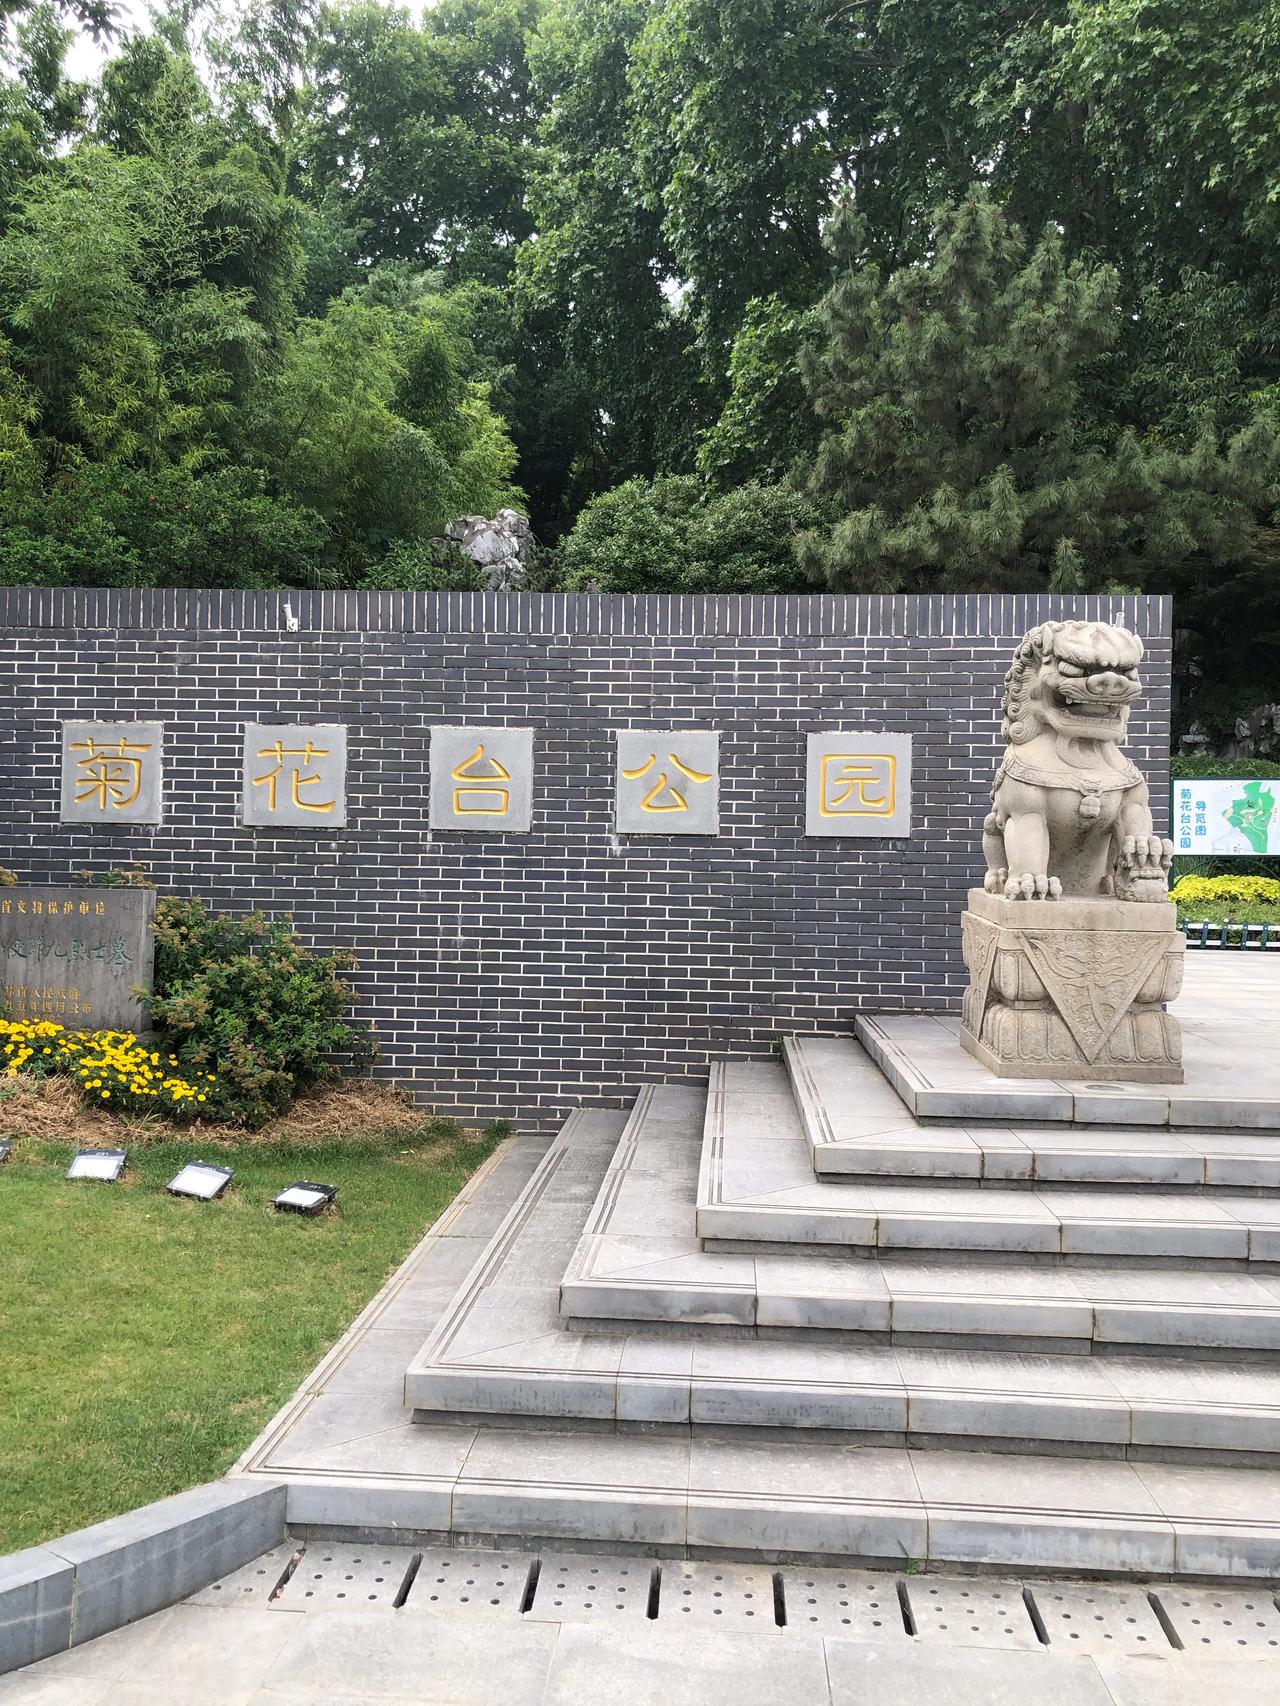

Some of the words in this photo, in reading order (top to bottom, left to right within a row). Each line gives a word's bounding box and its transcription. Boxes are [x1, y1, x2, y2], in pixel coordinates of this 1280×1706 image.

[69, 736, 897, 818] 菊花台公园
[1180, 788, 1192, 849] 菊花台公园
[1195, 800, 1207, 836] 导览图
[1, 899, 107, 916] 省文物保护单位
